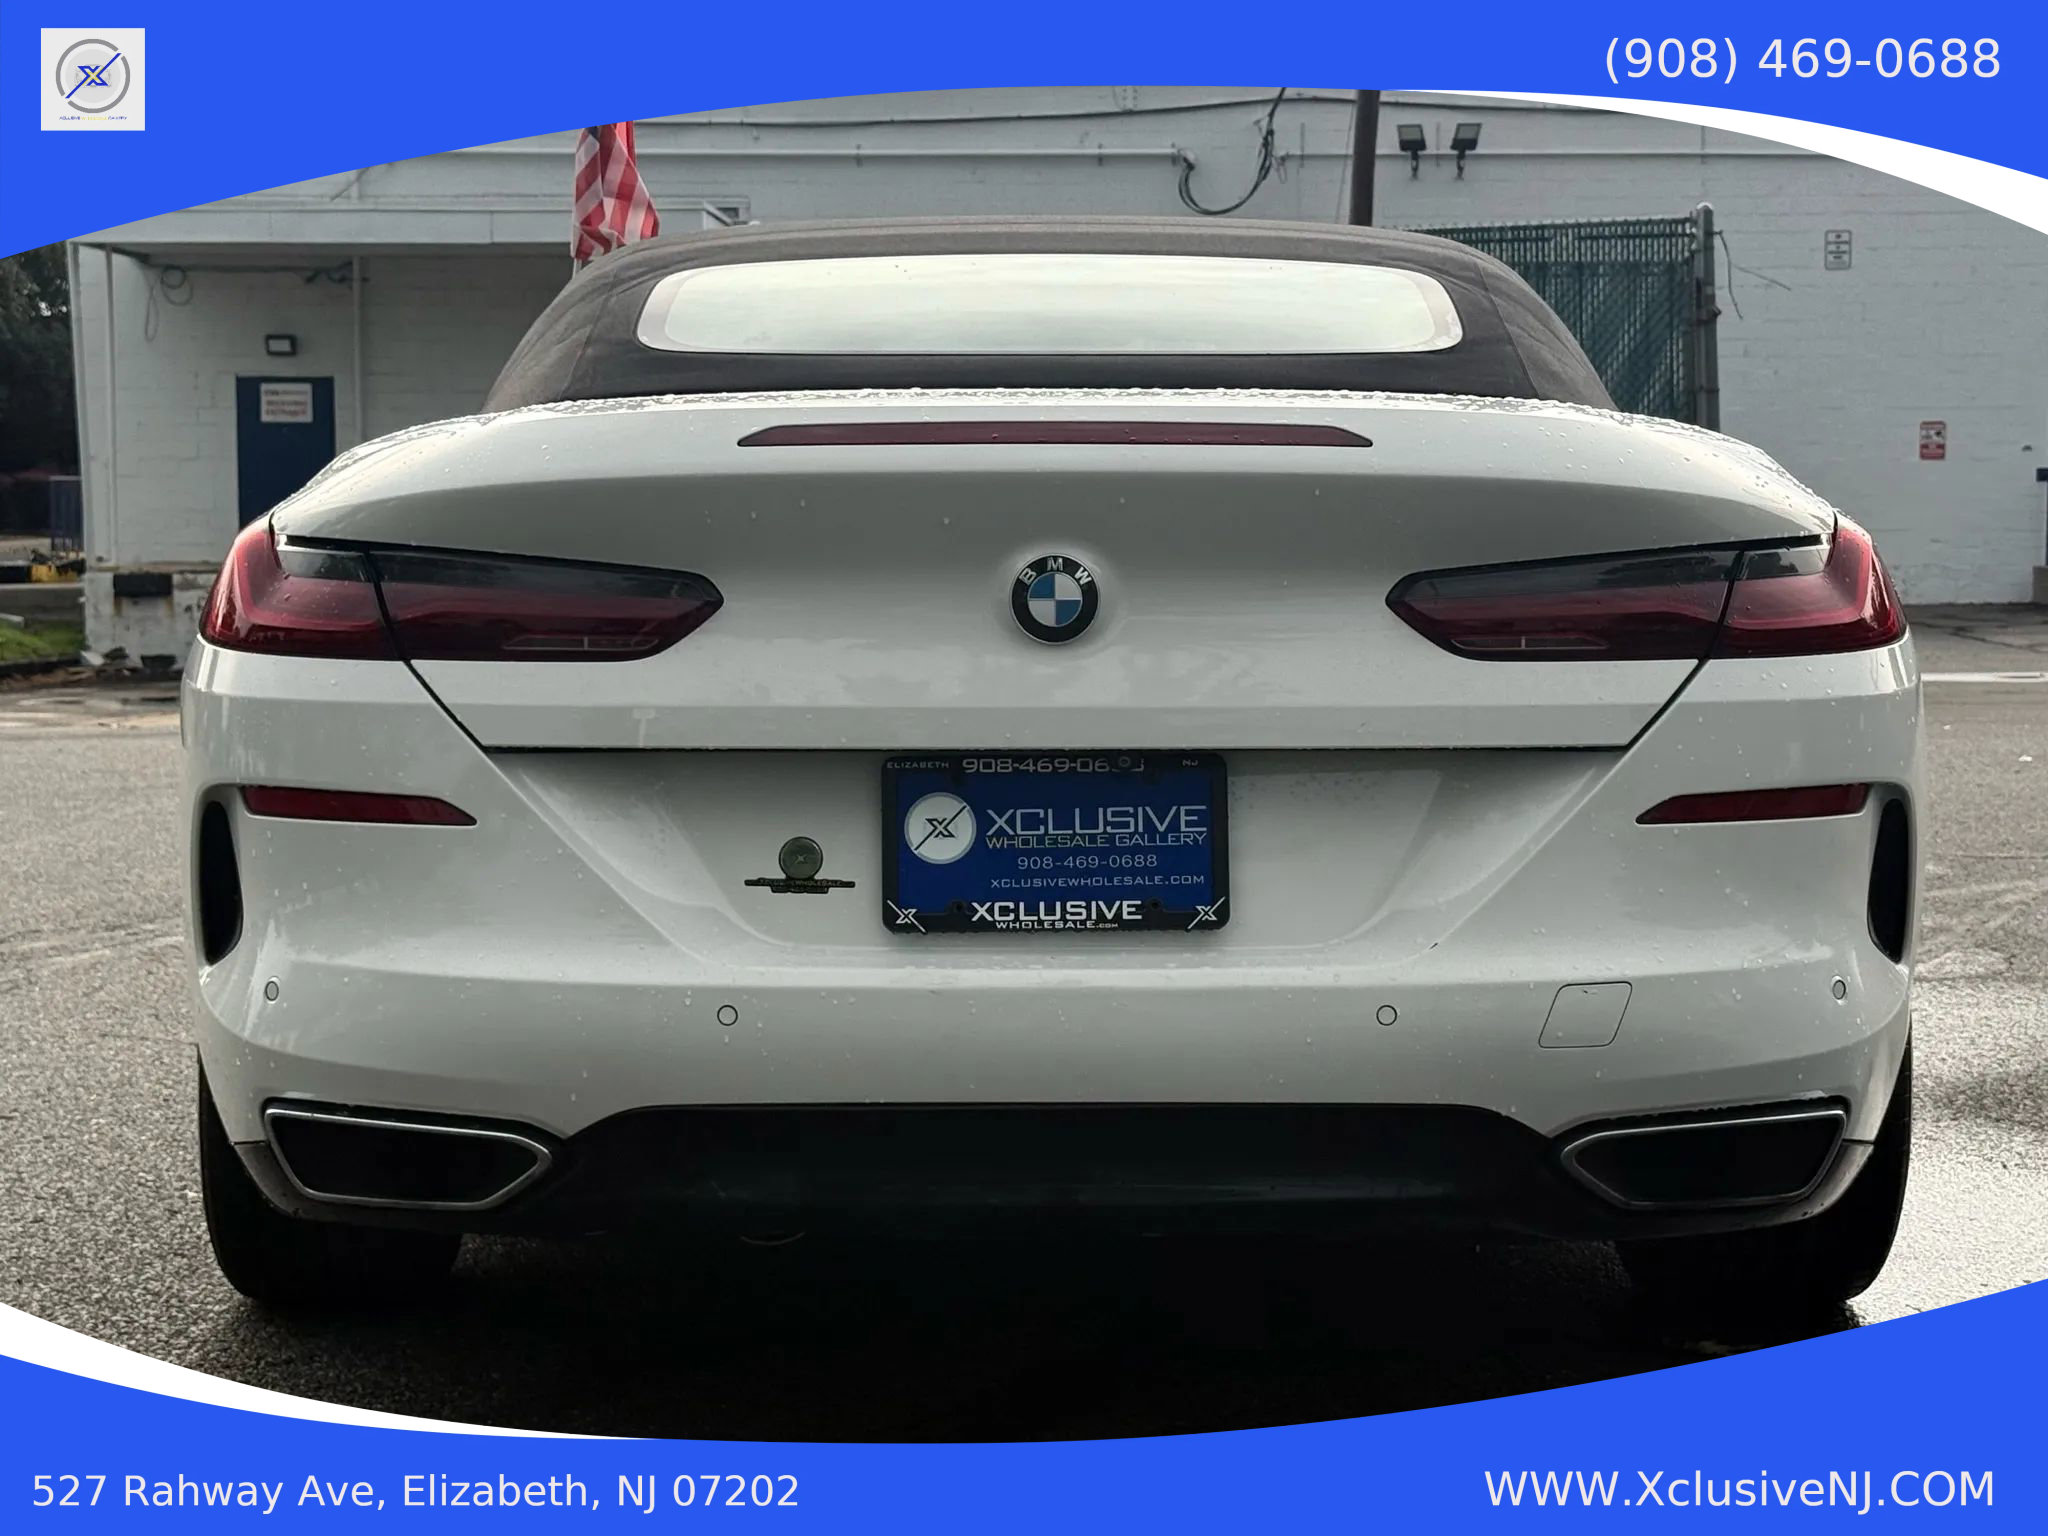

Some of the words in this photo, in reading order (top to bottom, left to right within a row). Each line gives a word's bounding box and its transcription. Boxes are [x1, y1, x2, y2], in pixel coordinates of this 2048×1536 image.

[1018, 556, 1093, 586] BMW
[886, 761, 950, 769] ELIZABETH
[962, 758, 1144, 773] 908-469-06
[1182, 759, 1199, 767] NJ
[985, 805, 1208, 836] XCLUSIVE
[985, 834, 1110, 849] WHOLESALE
[1115, 832, 1208, 847] GALLERY
[1017, 854, 1158, 870] 908-469-0688
[990, 875, 1205, 889] XCLUSIVEWHOLESALE.COM
[971, 900, 1143, 921] XCLUSIVE
